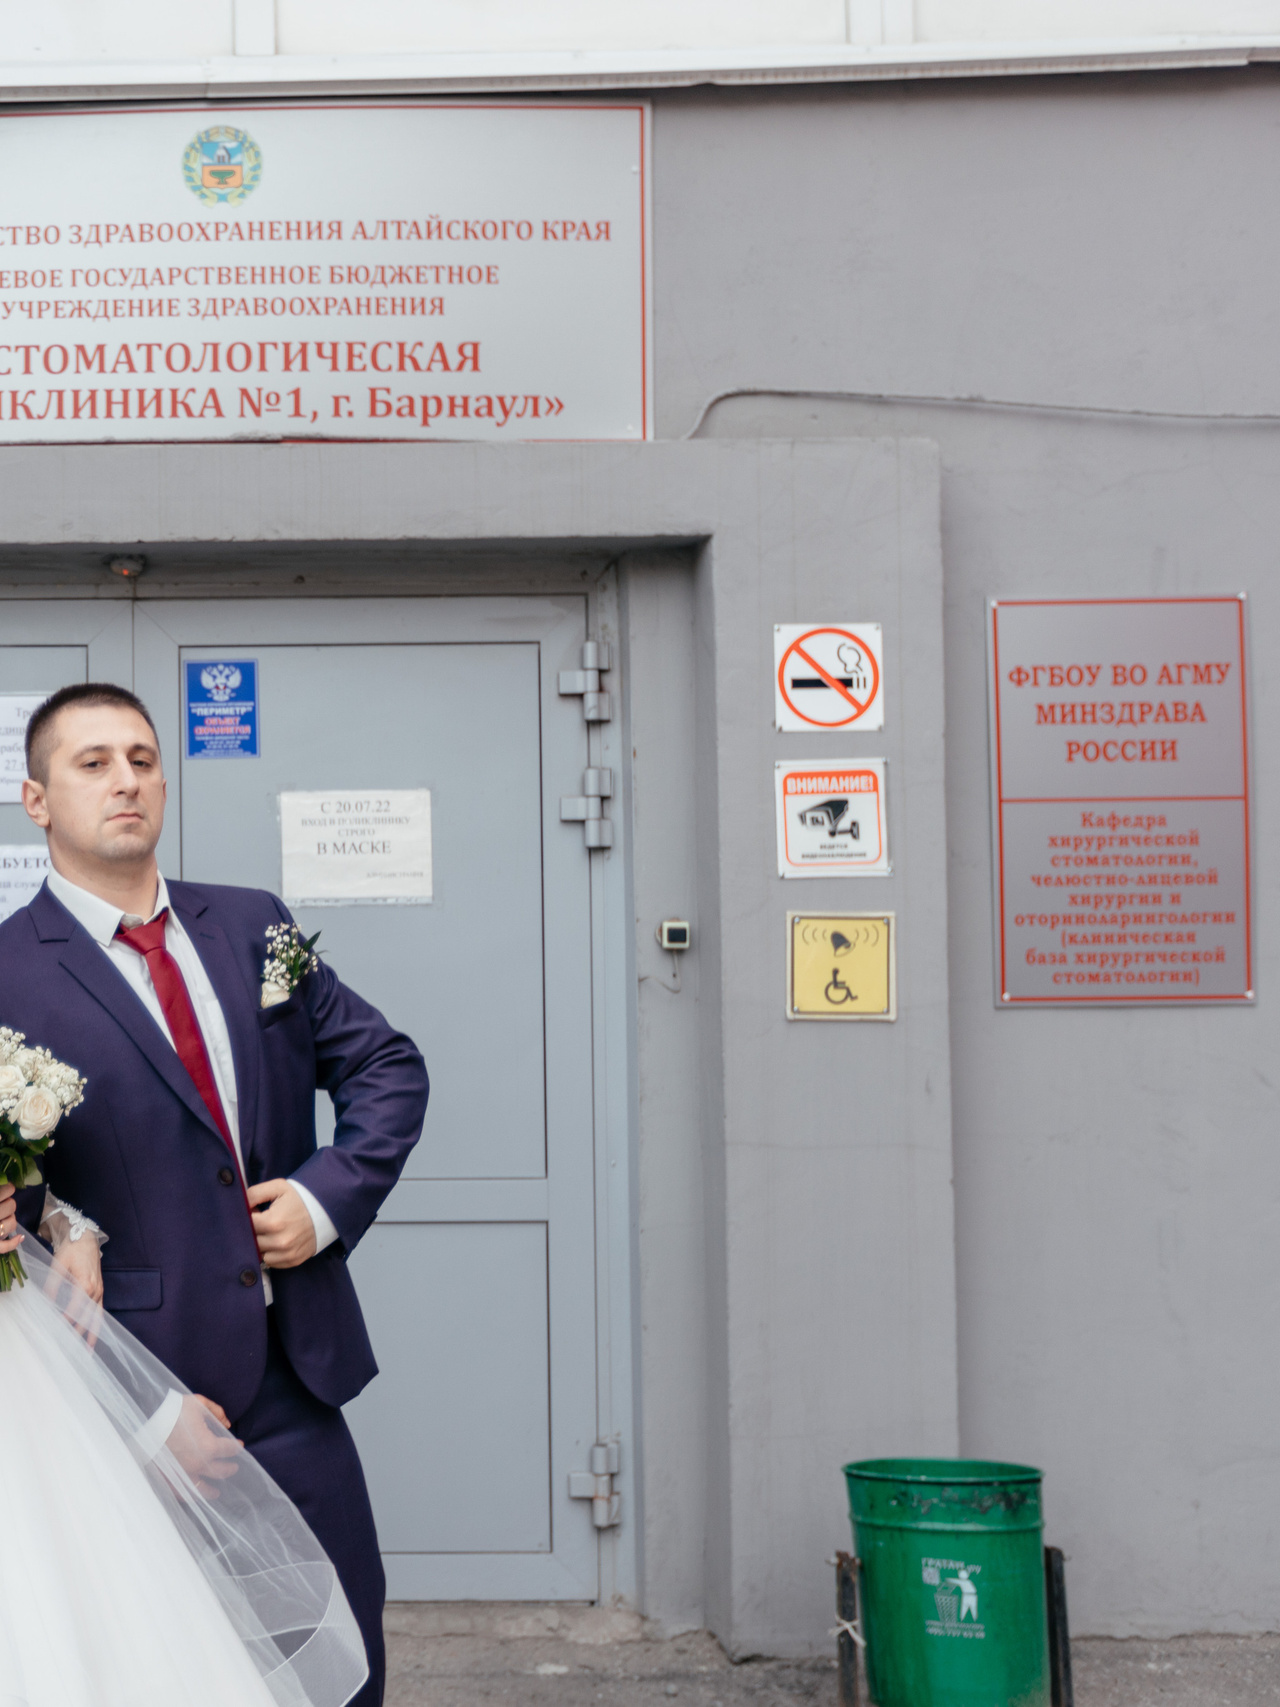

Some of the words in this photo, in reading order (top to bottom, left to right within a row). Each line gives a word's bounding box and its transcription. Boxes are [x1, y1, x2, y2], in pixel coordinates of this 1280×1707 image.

[68, 221, 345, 248] ЗДРАВООХРАНЕНИЯ
[350, 215, 533, 243] АЛТАЙСКОГО
[541, 219, 612, 243] КРАЯ
[70, 265, 321, 291] ГОСУДАРСТВЕННОЕ
[328, 264, 499, 290] БЮДЖЕТНОЕ
[0, 297, 181, 323] УЧРЕЖДЕНИЕ
[187, 295, 446, 321] ЗДРАВООХРАНЕНИЯ
[237, 386, 319, 425] №1,
[331, 392, 354, 419] г.
[366, 385, 565, 428] Барнаул»
[1007, 665, 1102, 687] ФГБОУ
[1111, 665, 1148, 686] ВО
[1156, 663, 1232, 685] АГМУ
[1035, 702, 1207, 726] МИНЗДРАВА
[1066, 741, 1178, 762] РОССИИ
[786, 775, 873, 793] ВНИМАНИЕ!
[336, 800, 391, 813] 20.07.22
[301, 818, 326, 826] ВХОД
[337, 816, 411, 825] ПОЛИКЛИНИКУ
[1081, 812, 1167, 830] Кафедра
[338, 829, 375, 837] СТРОГО
[1048, 830, 1200, 850] хирургической
[317, 842, 327, 855] В
[333, 841, 391, 855] МАСКЕ
[1050, 852, 1198, 869] стоматологии,
[1030, 869, 1218, 888] челюстно-лицевой
[1068, 892, 1163, 909] хирургии
[1169, 891, 1181, 905] и
[1015, 910, 1236, 929] оториноларингологии
[1061, 929, 1196, 947] (клиническая
[1025, 948, 1068, 966] база
[1074, 945, 1226, 967] хирургической
[1053, 967, 1200, 986] стоматологии)
